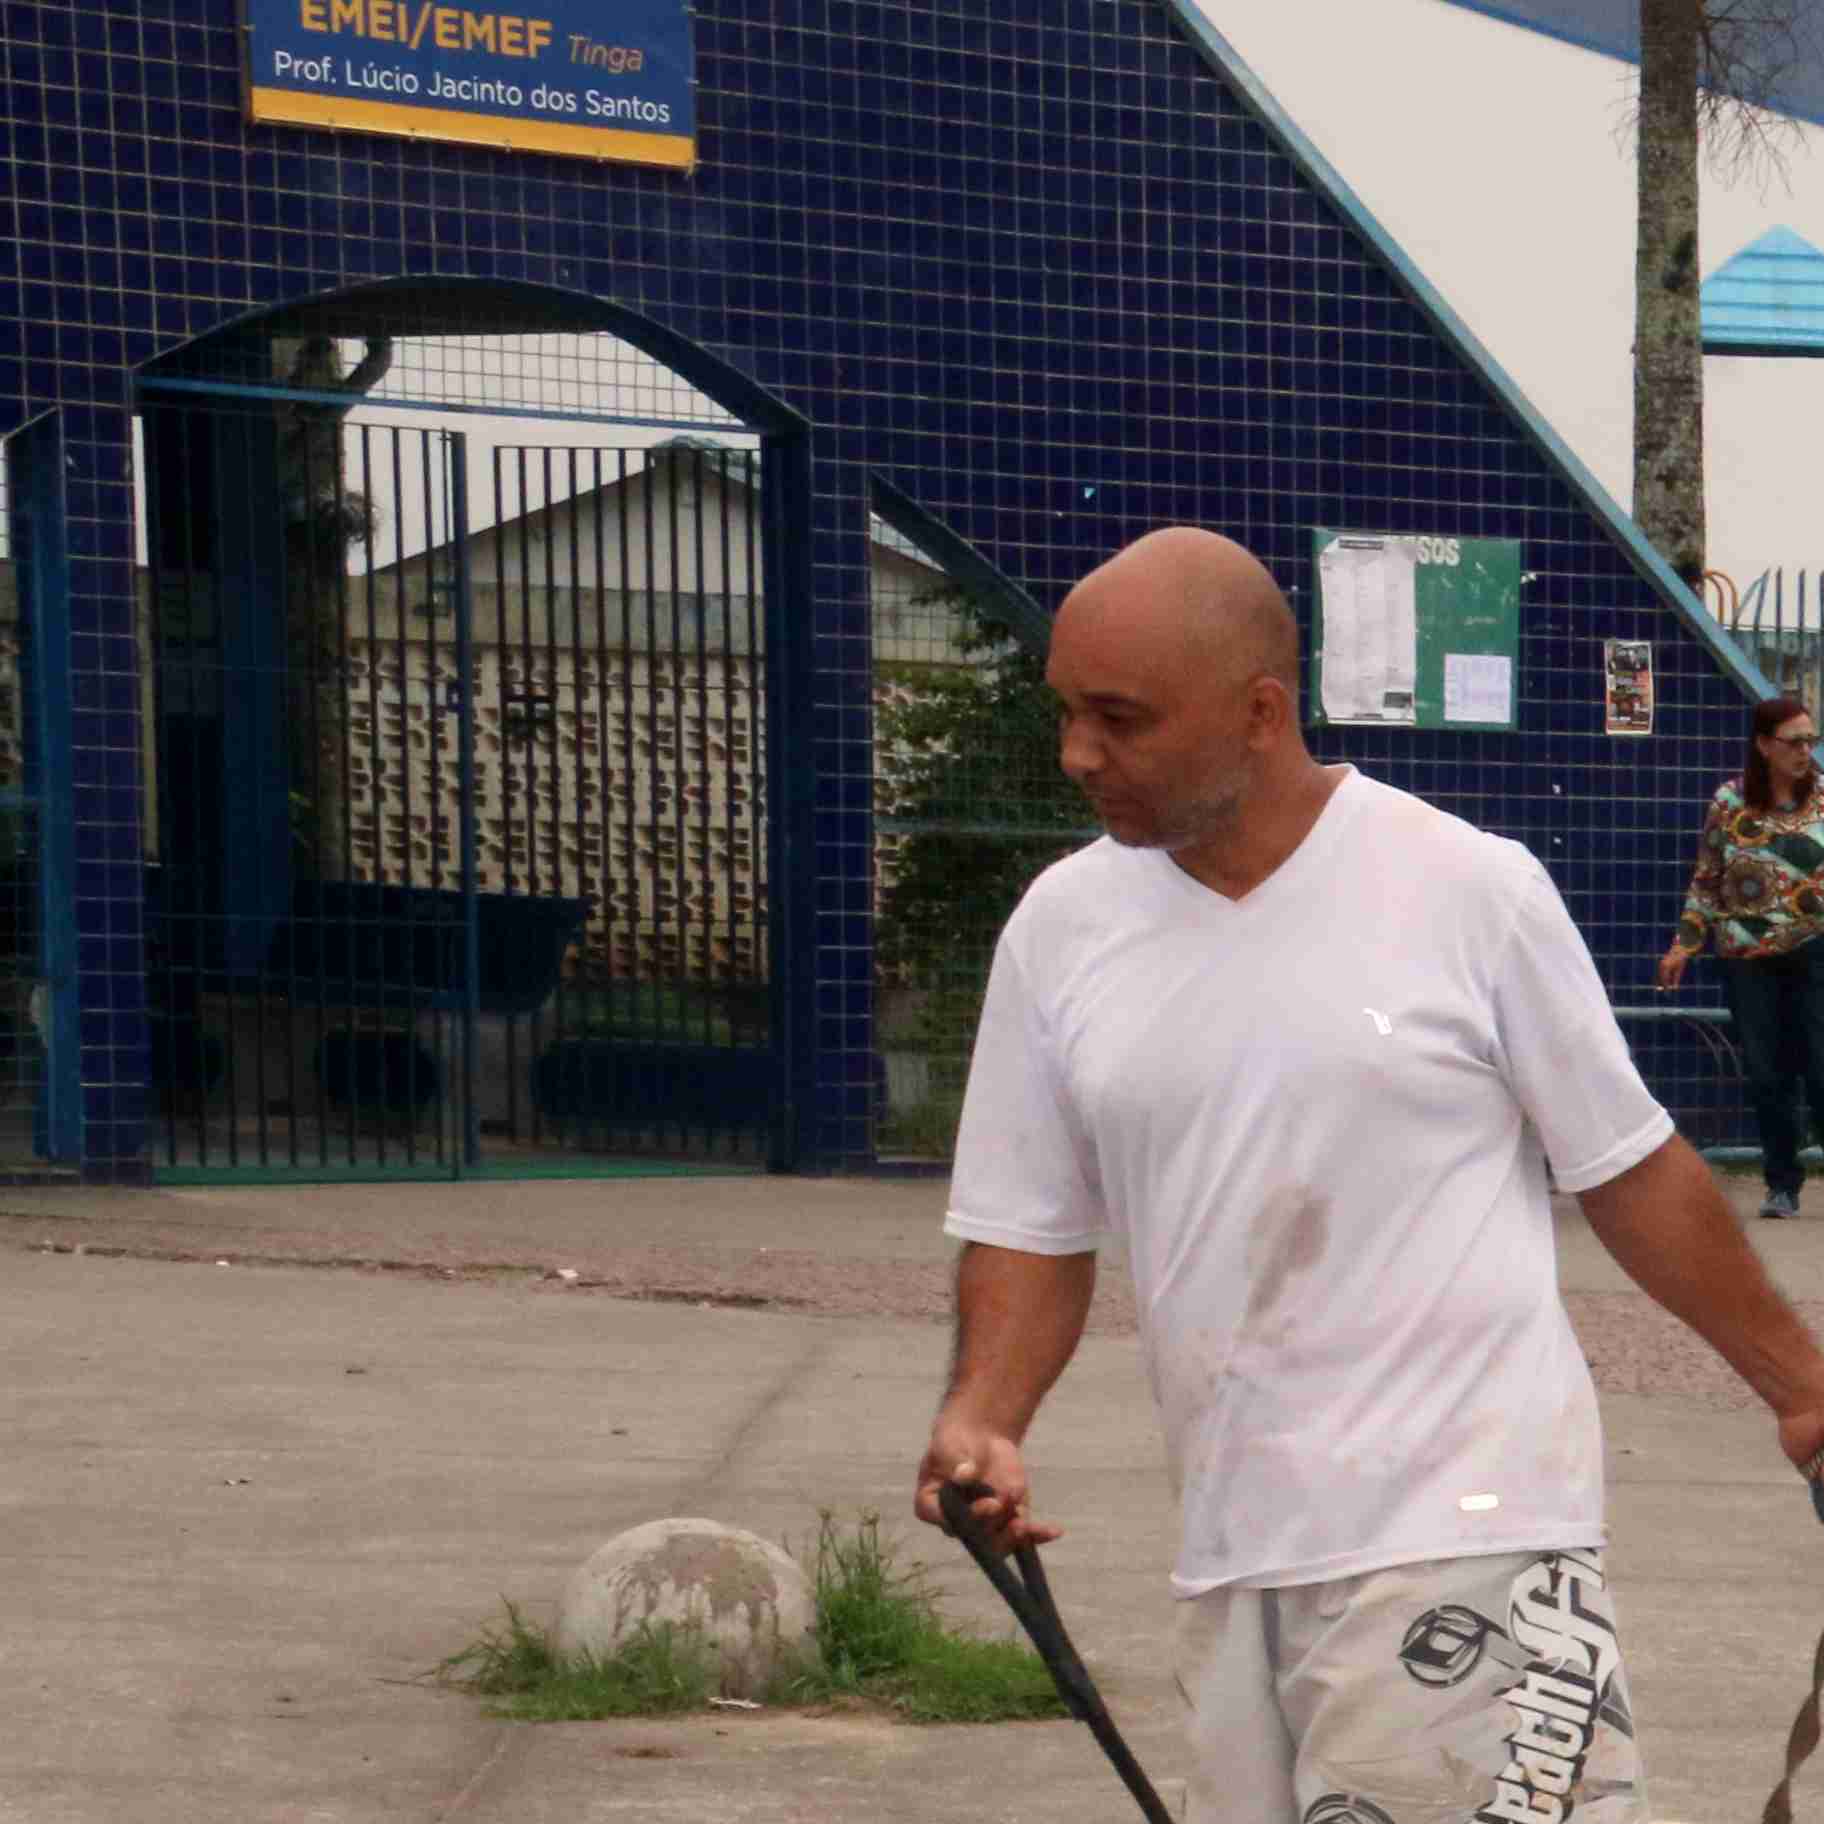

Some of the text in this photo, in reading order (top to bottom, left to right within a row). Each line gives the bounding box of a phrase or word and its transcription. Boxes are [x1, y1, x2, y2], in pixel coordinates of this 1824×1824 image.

[299, 0, 645, 73] EMEI/EMEF Tinga
[274, 51, 671, 124] Prof. Lúcio Jacinto dos Santos
